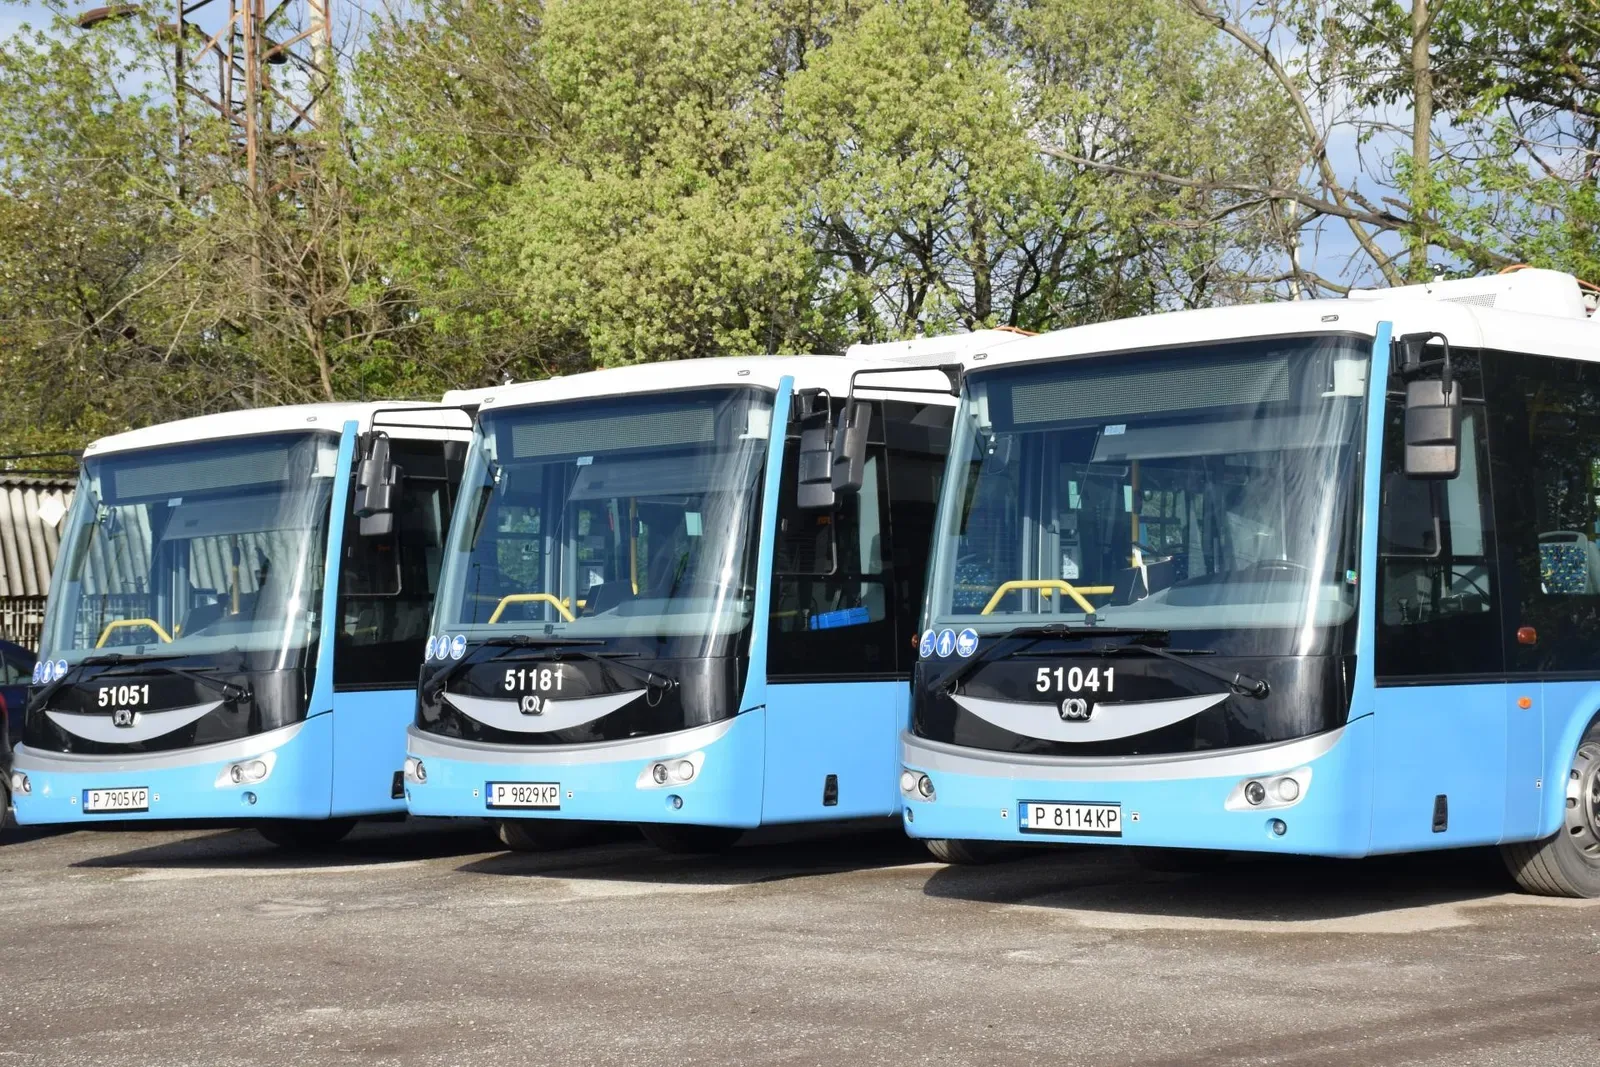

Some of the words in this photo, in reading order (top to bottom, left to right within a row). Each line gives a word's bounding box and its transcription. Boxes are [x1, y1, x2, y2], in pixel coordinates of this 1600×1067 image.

[504, 668, 562, 691] 51181
[1036, 666, 1114, 692] 51041
[98, 684, 149, 707] 51051
[93, 793, 100, 807] P
[105, 791, 146, 807] 7905KP
[498, 787, 505, 803] P
[511, 787, 557, 803] 9829KP
[1035, 807, 1045, 825] P
[1054, 808, 1117, 828] 8114KP
